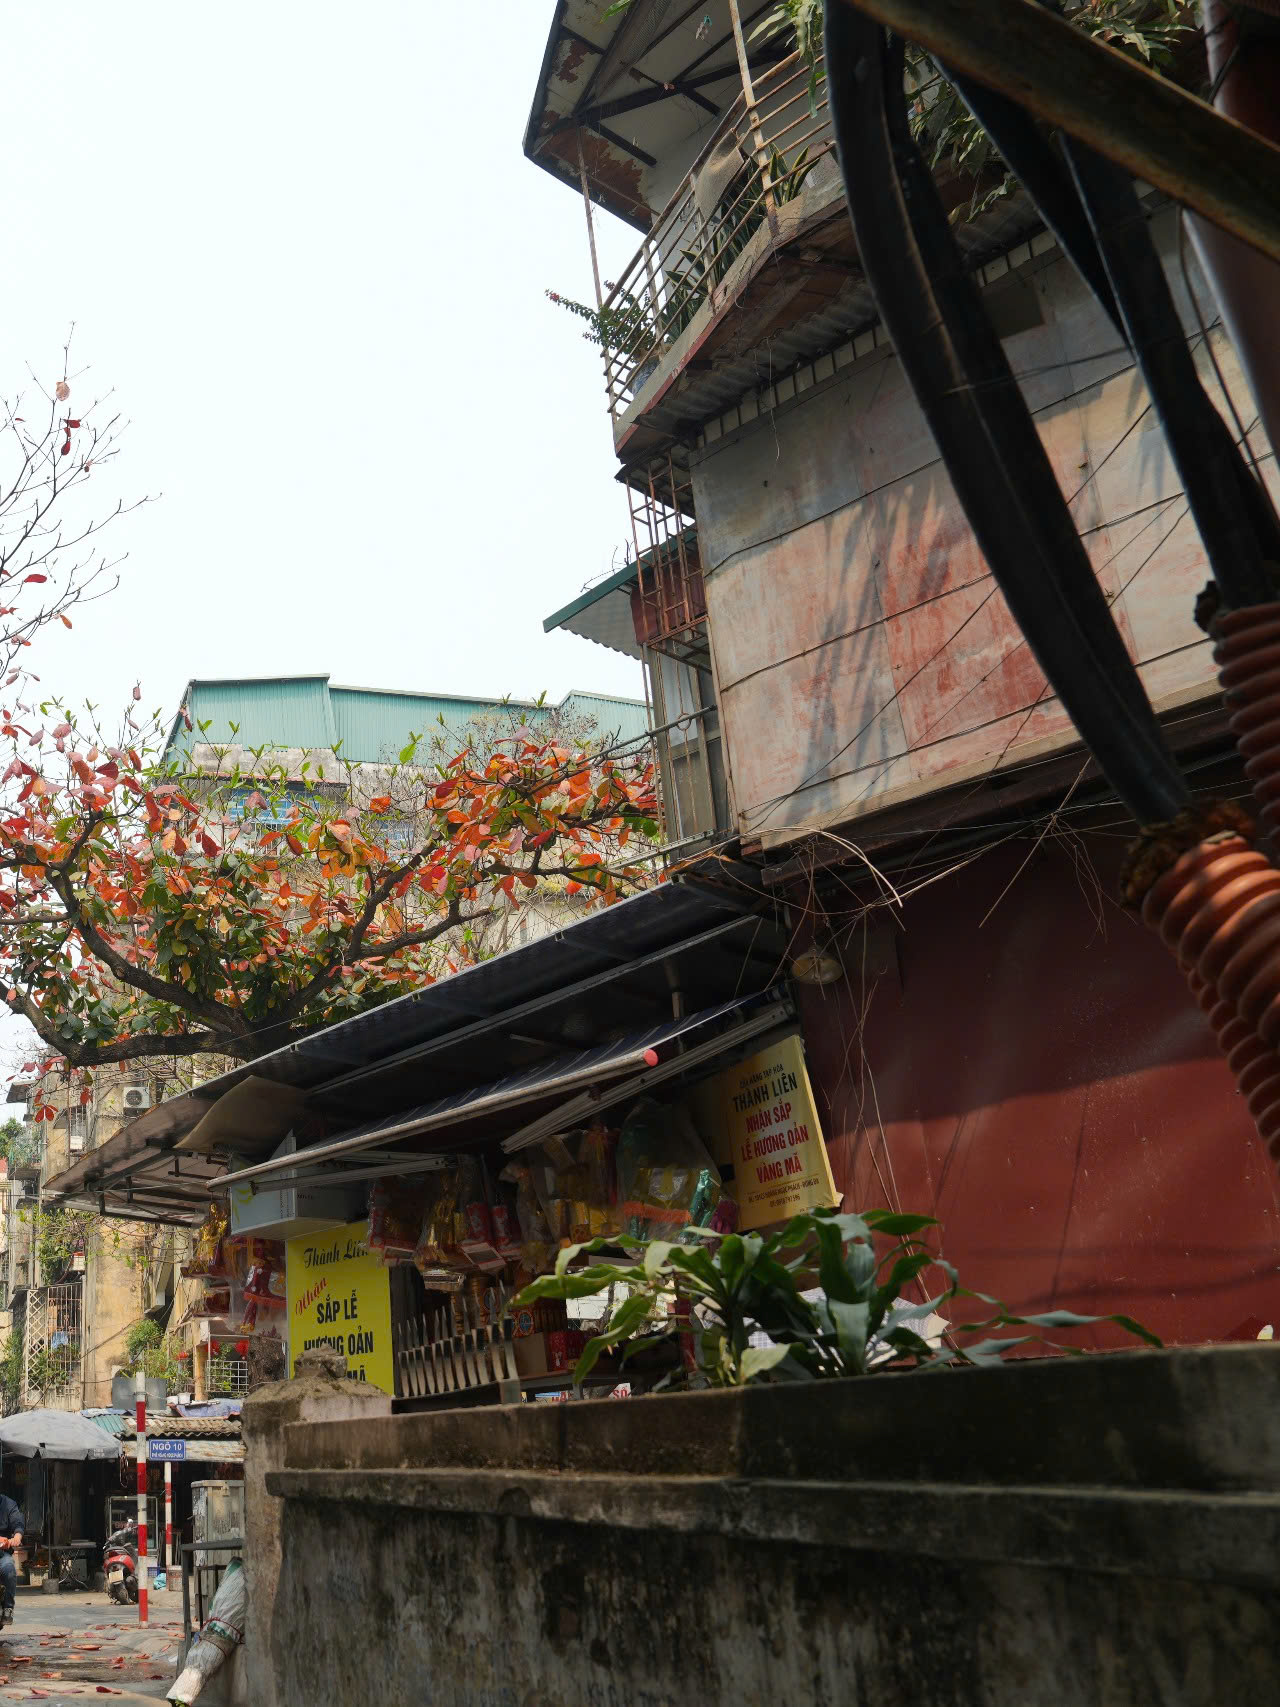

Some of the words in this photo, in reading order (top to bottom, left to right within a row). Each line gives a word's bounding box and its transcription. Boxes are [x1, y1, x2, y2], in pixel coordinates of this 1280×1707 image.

[733, 1085, 770, 1113] THÀNH
[771, 1071, 798, 1097] LIÊN
[745, 1107, 774, 1134] NHẬN
[773, 1097, 792, 1125] SẮP
[740, 1138, 753, 1162] LỄ
[754, 1130, 787, 1158] HƯƠNG
[787, 1121, 810, 1146] OẢN
[756, 1161, 783, 1184] VÀNG
[784, 1151, 803, 1175] MÃ
[303, 1243, 340, 1269] Thành
[316, 1294, 341, 1325] SẮP
[343, 1289, 359, 1320] LỄ
[347, 1325, 374, 1356] OẢN
[152, 1441, 171, 1451] NGÕ
[172, 1443, 182, 1451] 10
